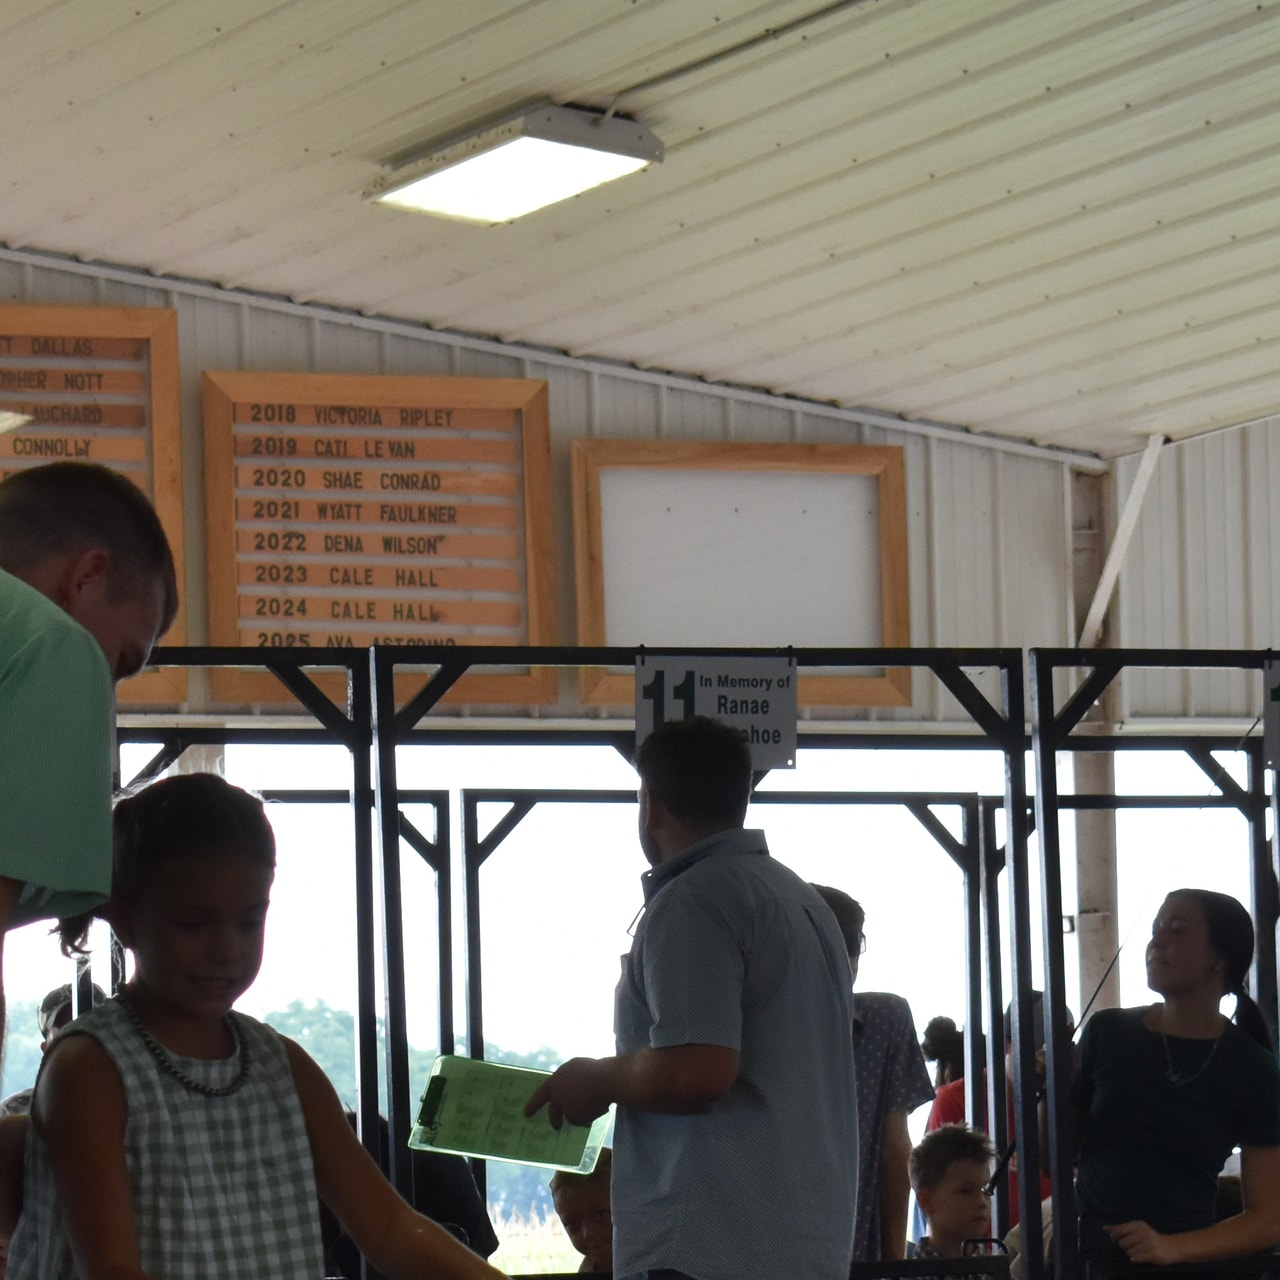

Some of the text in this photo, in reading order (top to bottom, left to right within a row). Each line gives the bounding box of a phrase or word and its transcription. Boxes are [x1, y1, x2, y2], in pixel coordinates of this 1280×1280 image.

[31, 337, 93, 357] DALLAS
[64, 373, 104, 391] NOTT
[250, 403, 453, 427] 2018 VICTORIA RIPLEY
[12, 437, 91, 457] CONNOLLY
[251, 437, 297, 454] 2019
[314, 438, 348, 457] CATI
[253, 469, 441, 491] 2020 SHAE CONRAD
[253, 500, 458, 524] 2021 WYATT FAULKNER
[254, 532, 438, 554] 2022 DENA WILSON
[255, 564, 440, 587] 2023 CALE HALL
[256, 598, 438, 621] 2024 CALE HALL
[258, 632, 311, 647] 2025
[699, 674, 790, 691] In Memory of
[642, 670, 696, 732] 11
[717, 695, 770, 715] Ranae
